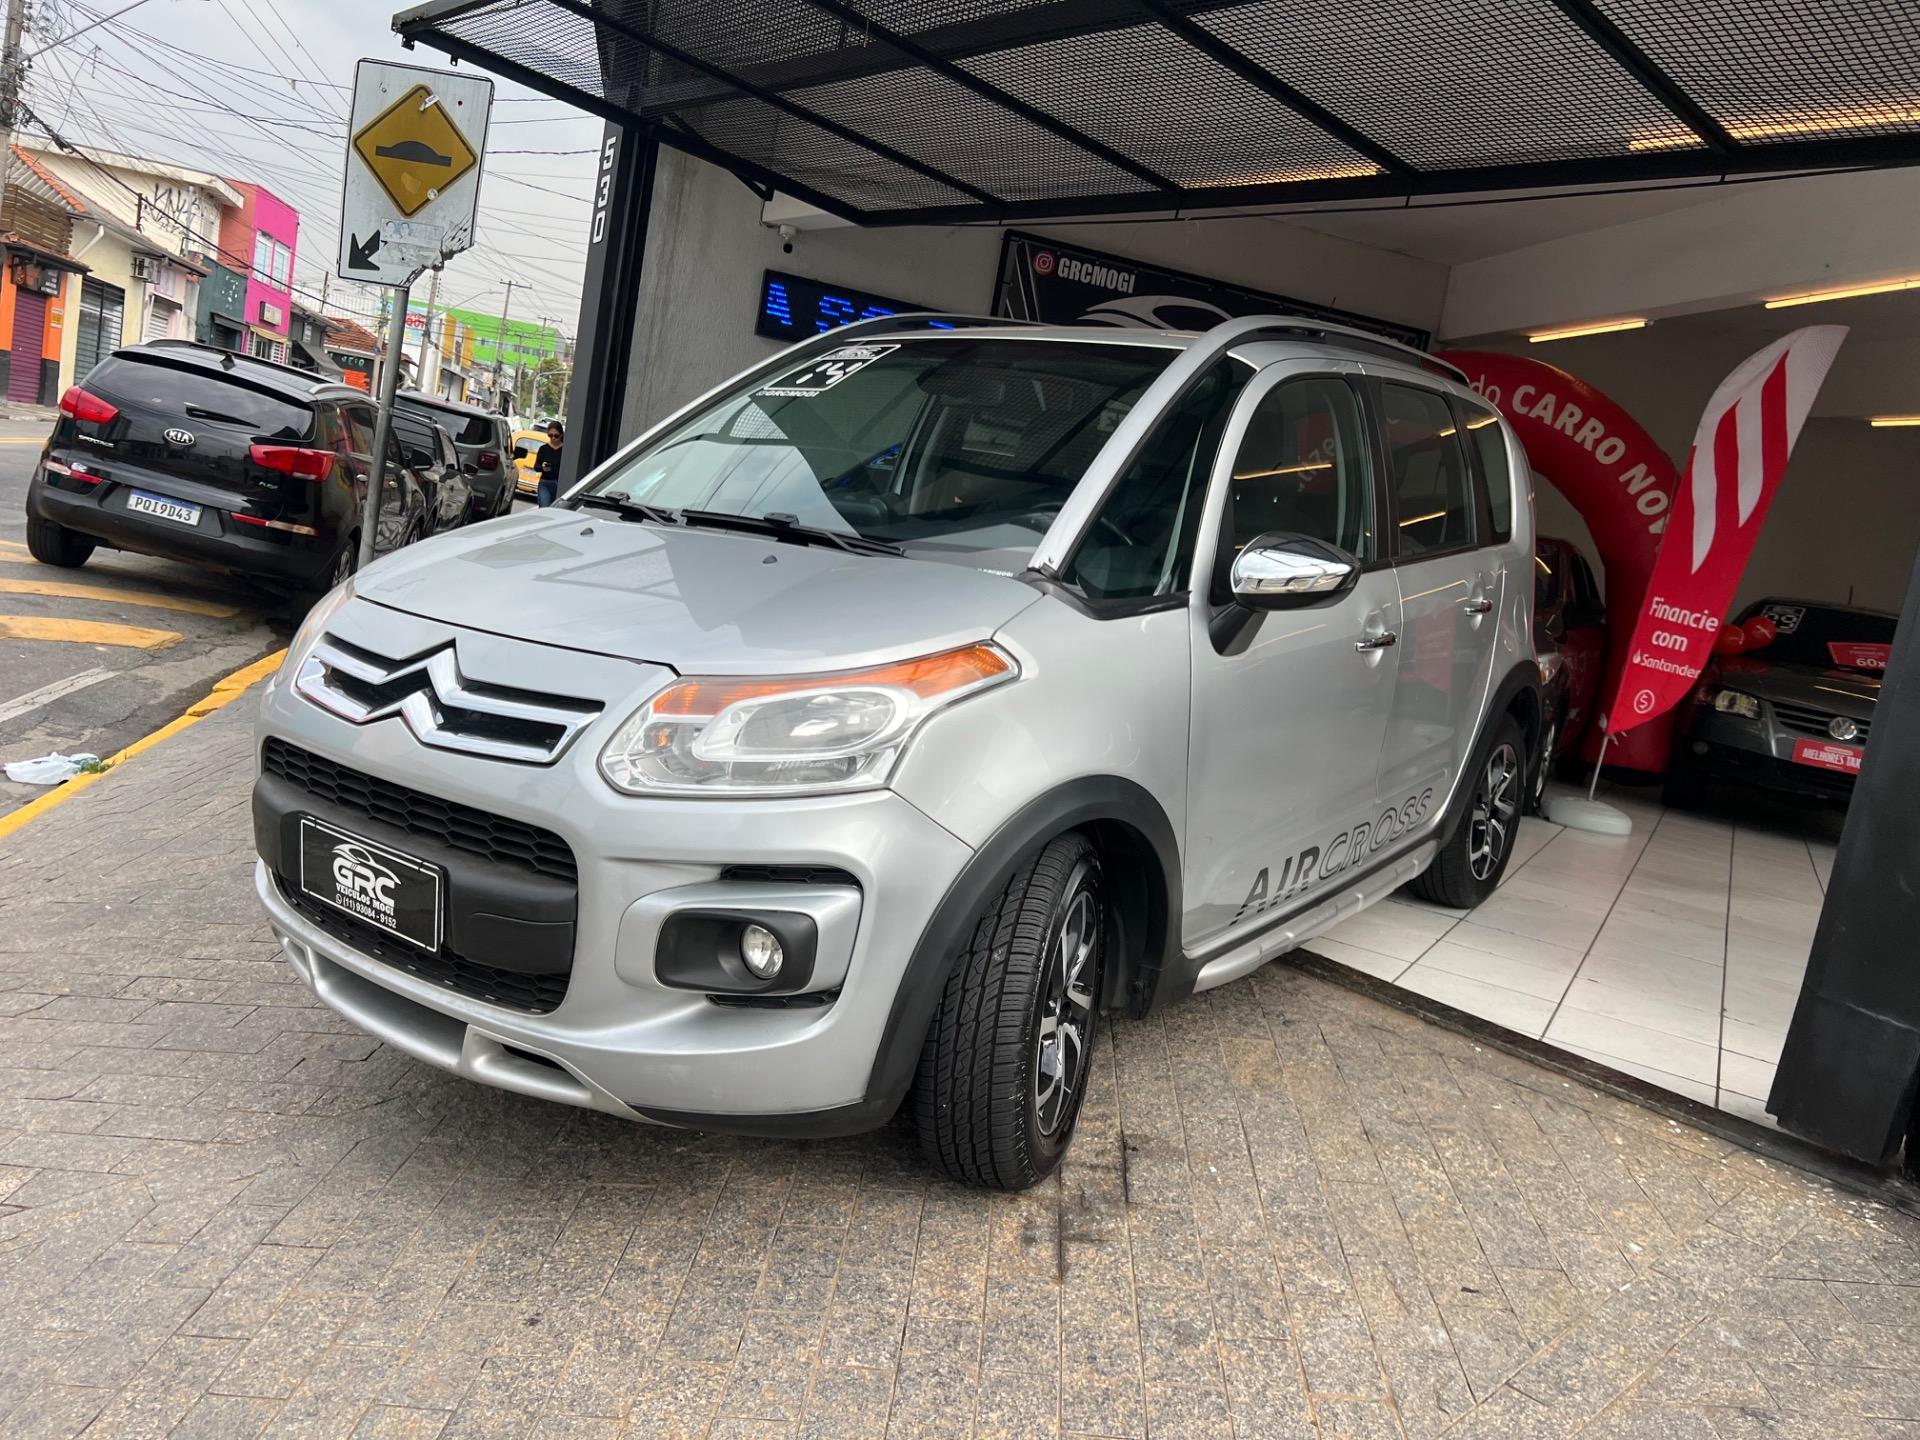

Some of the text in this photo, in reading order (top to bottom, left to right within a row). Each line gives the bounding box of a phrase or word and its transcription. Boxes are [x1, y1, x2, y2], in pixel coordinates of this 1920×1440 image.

[593, 136, 617, 244] 530
[1057, 256, 1136, 294] GRCMOGI
[168, 429, 191, 444] KIA
[1512, 385, 1626, 465] CARRO
[1648, 596, 1719, 632] Financie
[1651, 630, 1688, 652] com
[1641, 653, 1701, 680] Santander
[1229, 787, 1433, 926] AIRCROSS
[333, 857, 395, 907] GRC
[336, 882, 395, 916] VEICULOS MOGI
[343, 897, 356, 912] (11)
[355, 902, 376, 920] 93084
[379, 913, 397, 929] 9152
